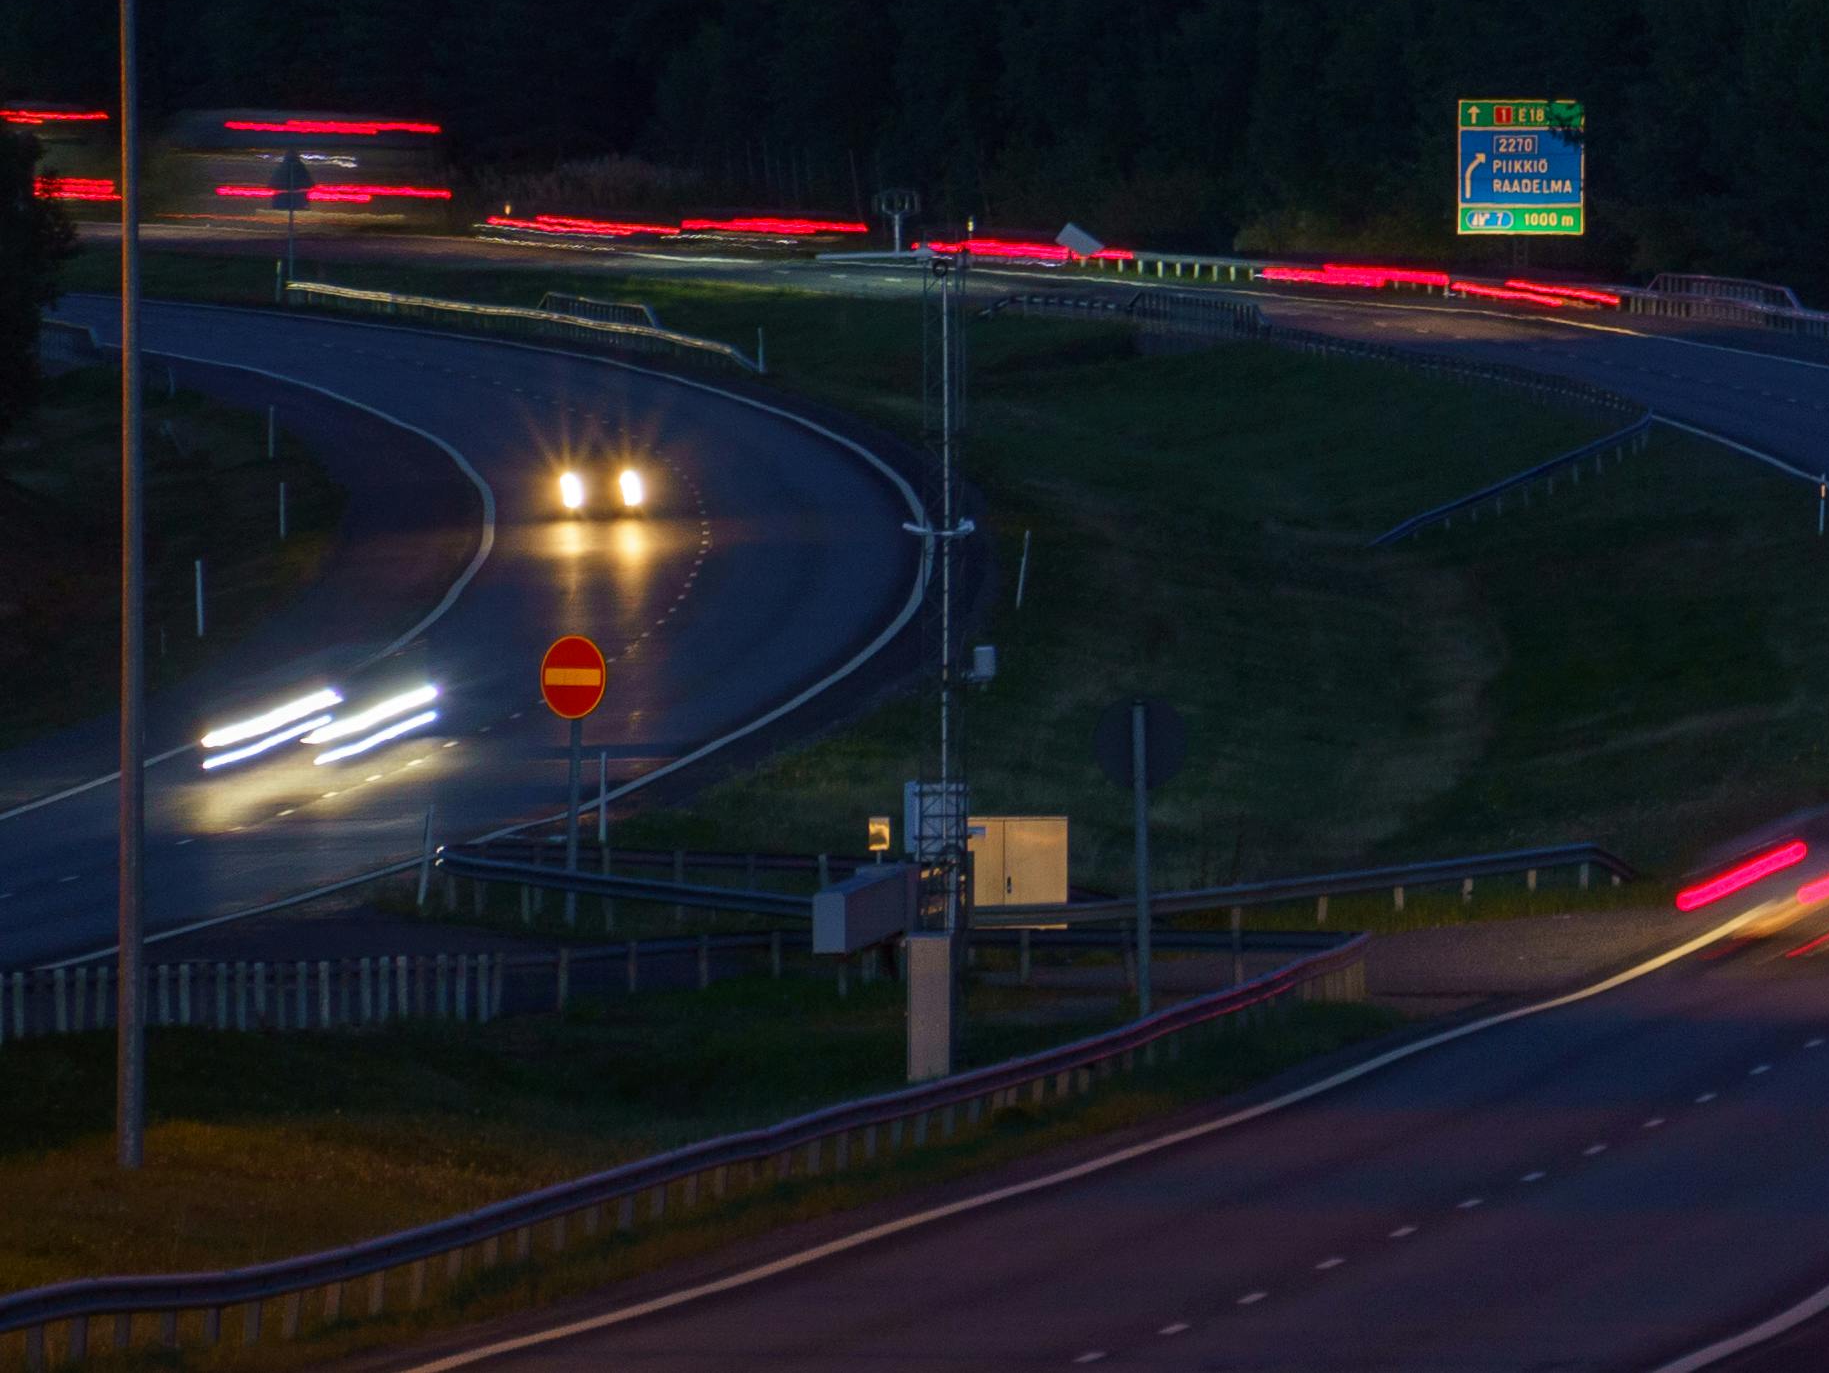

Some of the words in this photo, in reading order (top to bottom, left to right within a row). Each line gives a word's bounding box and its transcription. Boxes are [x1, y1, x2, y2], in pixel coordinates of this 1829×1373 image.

[1499, 138, 1532, 152] 2270
[1493, 159, 1548, 173] PIIKKIÖ
[1493, 179, 1572, 193] RAADELMA
[1497, 213, 1503, 226] 7
[1524, 213, 1557, 226] 1000
[1561, 215, 1574, 226] m
